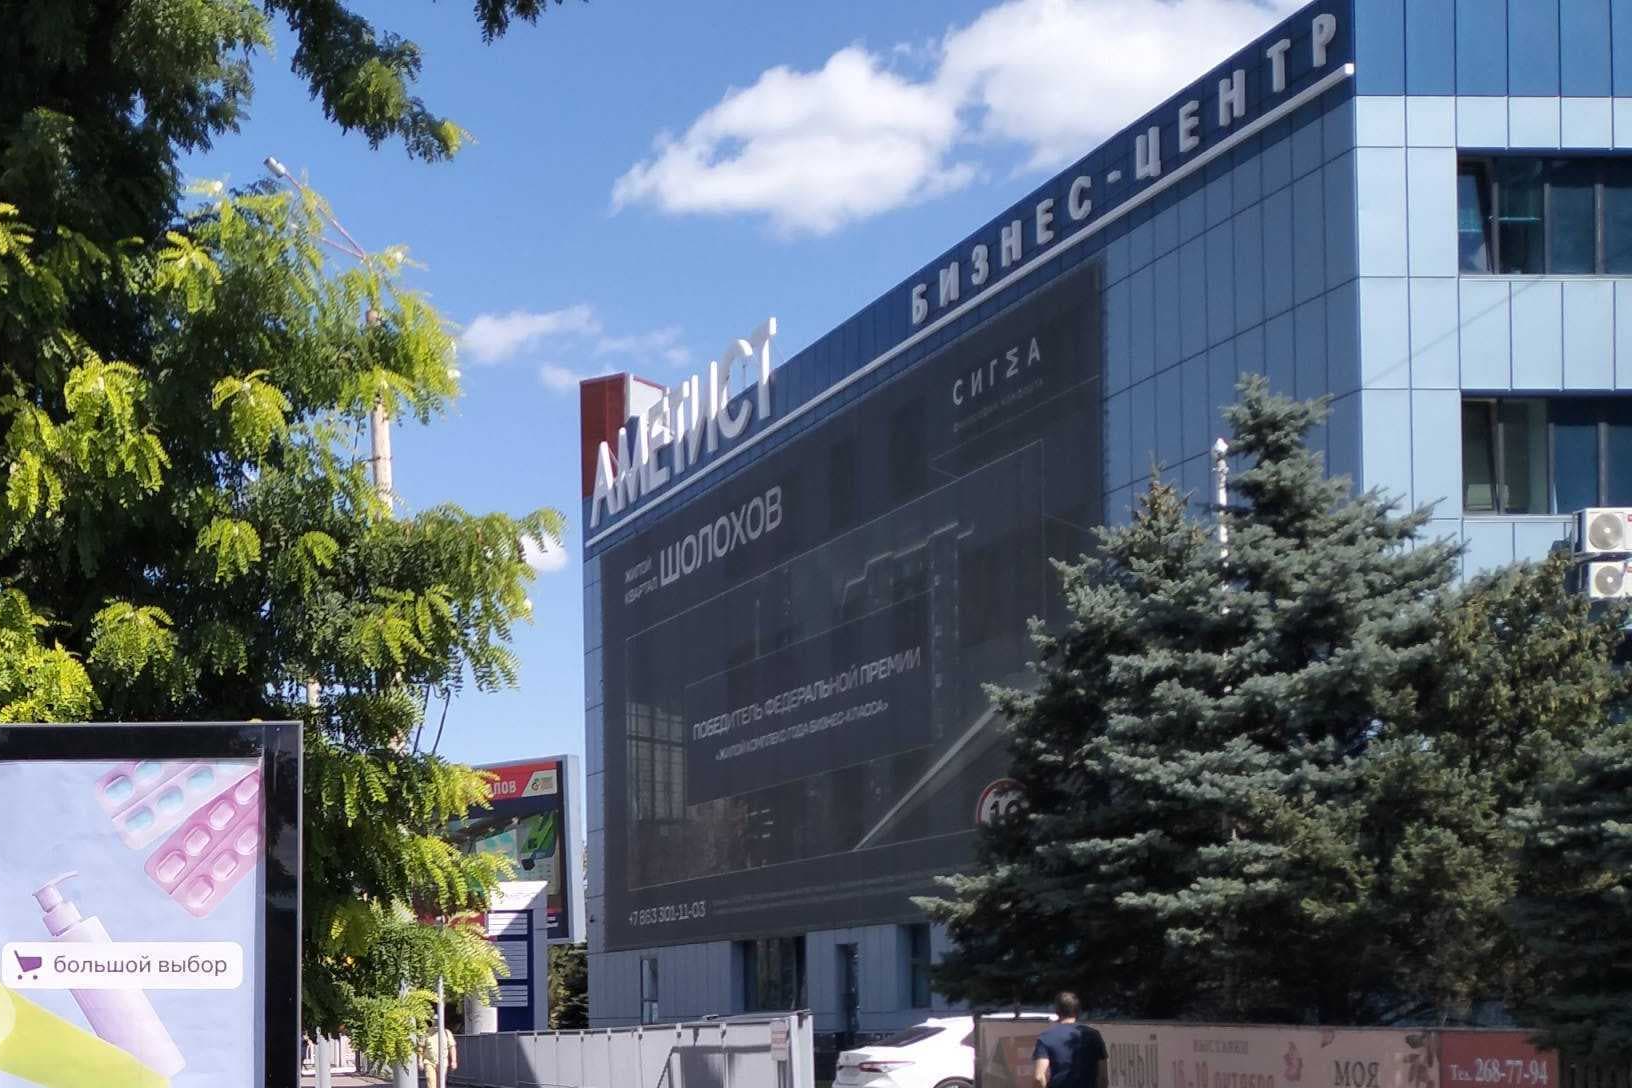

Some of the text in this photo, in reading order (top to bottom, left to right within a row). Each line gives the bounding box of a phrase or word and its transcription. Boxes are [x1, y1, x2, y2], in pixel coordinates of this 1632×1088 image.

[909, 13, 1337, 326] БИЗНЕС-ЦЕНТР
[590, 316, 777, 529] АМЕТИСТ
[659, 485, 783, 588] ШОЛОХОВ
[693, 646, 921, 740] ПОБЕДИТЕЛЬ ФЕДЕРАЛЬНОЙ ПРЕМИИ
[54, 953, 228, 977] большой выбор
[1334, 1060, 1380, 1088] МОЯ
[1474, 1057, 1549, 1085] 268-77-94
